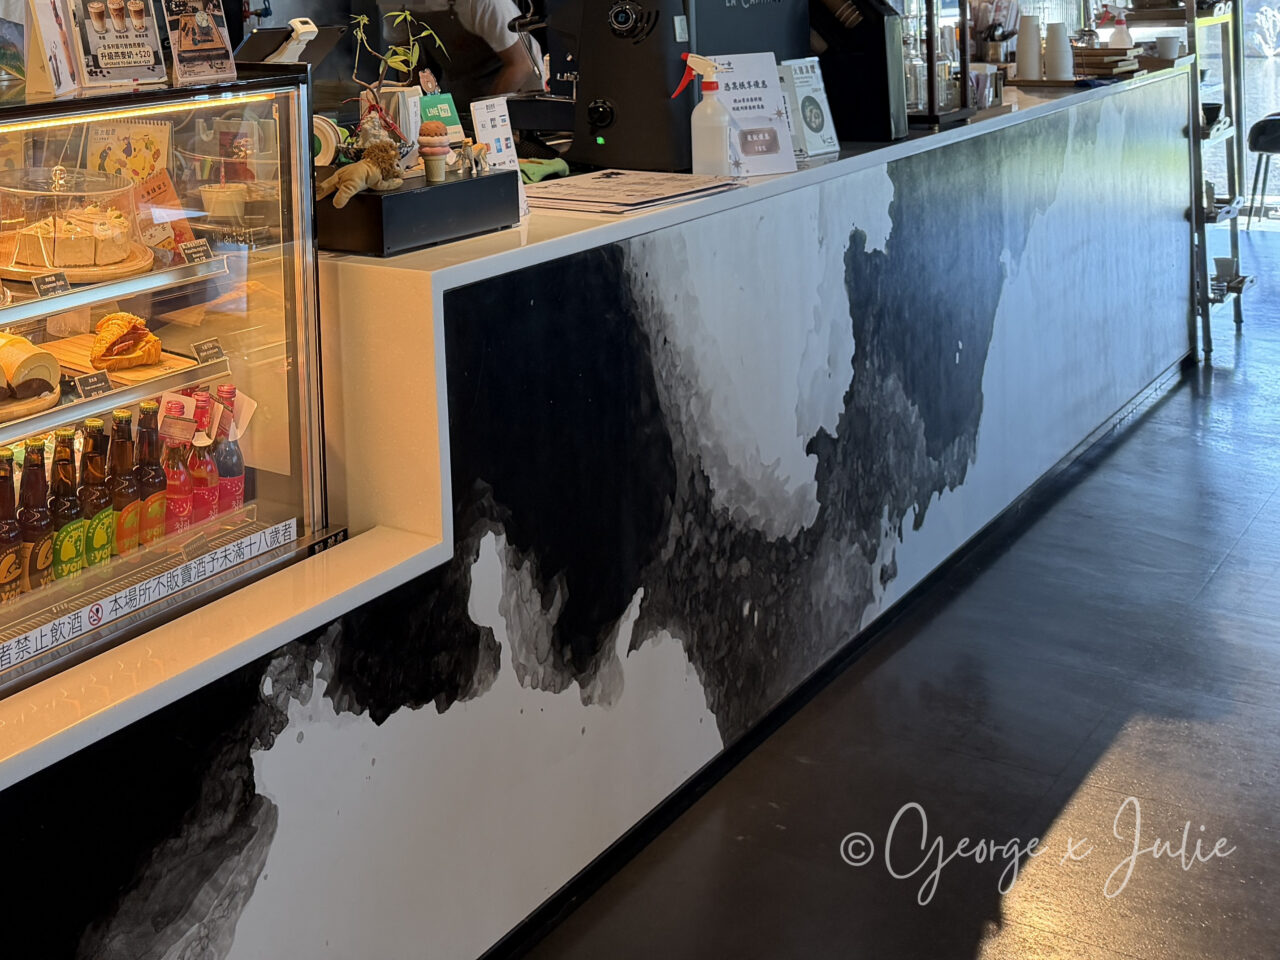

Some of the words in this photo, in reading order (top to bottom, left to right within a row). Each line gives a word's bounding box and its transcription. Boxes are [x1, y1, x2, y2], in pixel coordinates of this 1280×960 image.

[426, 107, 439, 117] LINE
[108, 523, 293, 617] 本場所不販賣酒予未滿十八歲者
